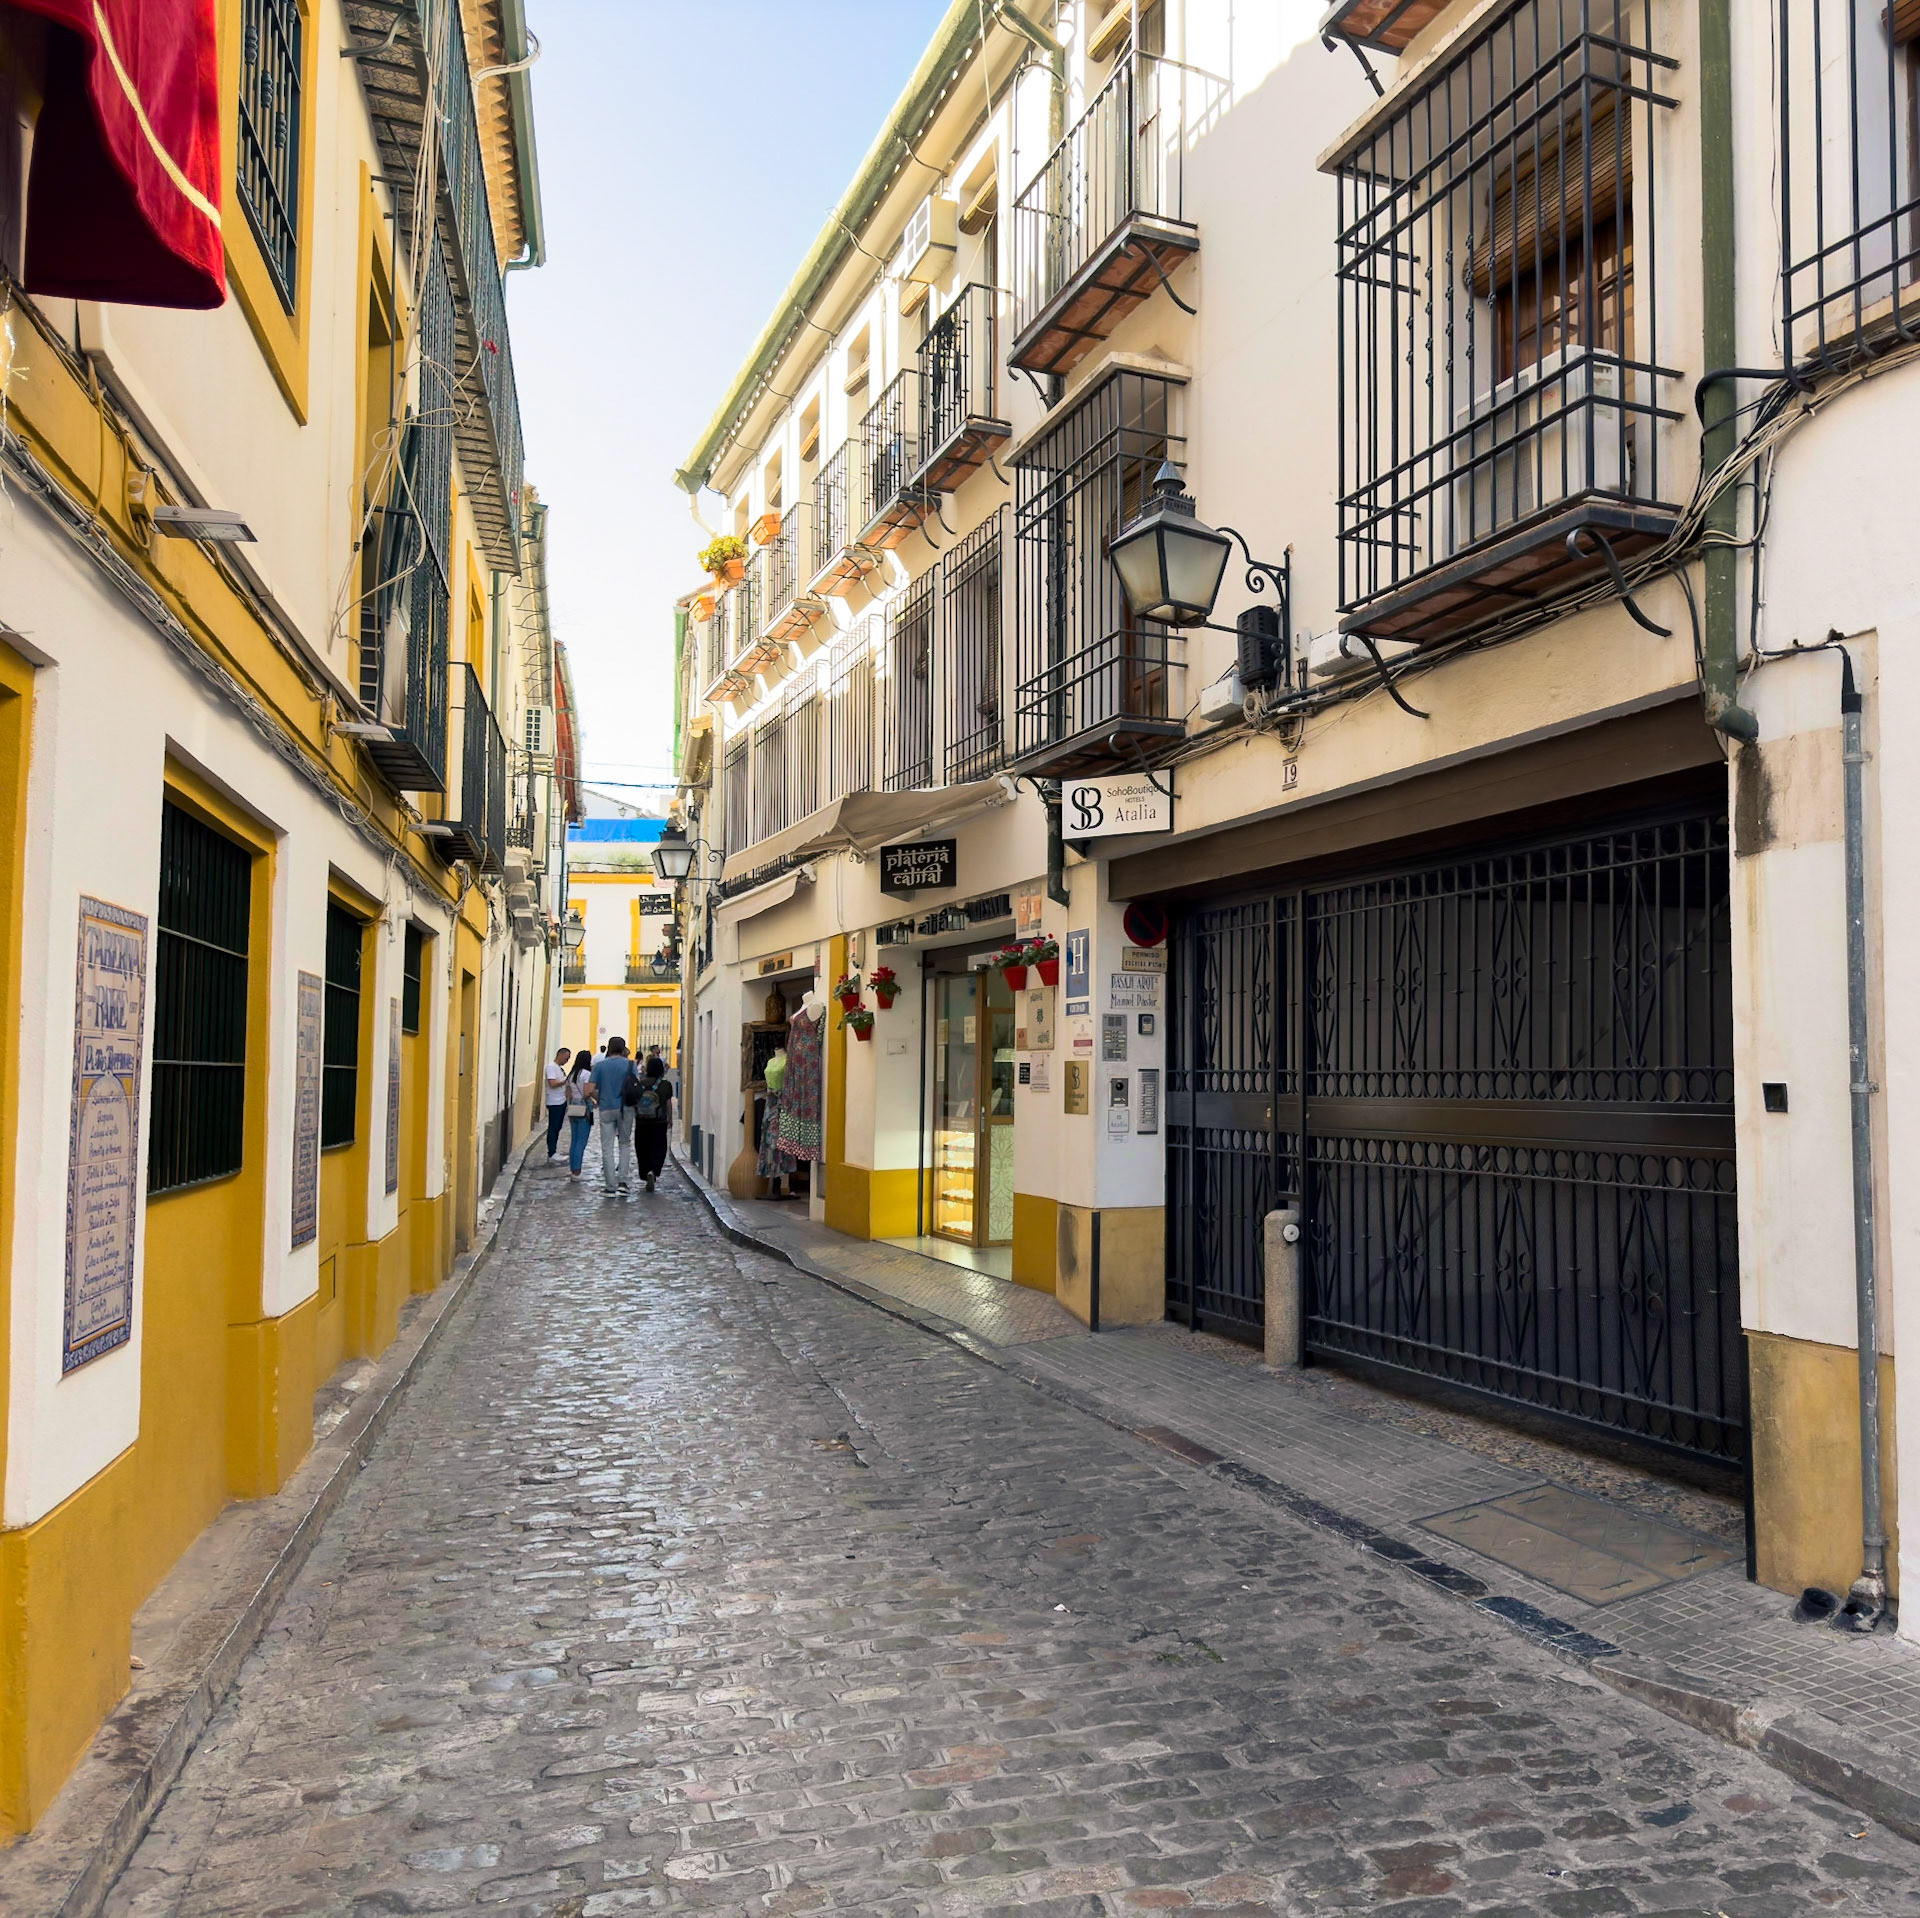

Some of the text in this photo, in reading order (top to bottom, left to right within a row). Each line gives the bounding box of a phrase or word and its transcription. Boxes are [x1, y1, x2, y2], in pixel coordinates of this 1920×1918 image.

[1284, 764, 1297, 783] 19
[1125, 796, 1145, 804] HOTELS
[1115, 804, 1156, 823] Atalia
[892, 863, 943, 886] califal
[86, 925, 142, 982] TABERNA
[1071, 936, 1085, 975] H
